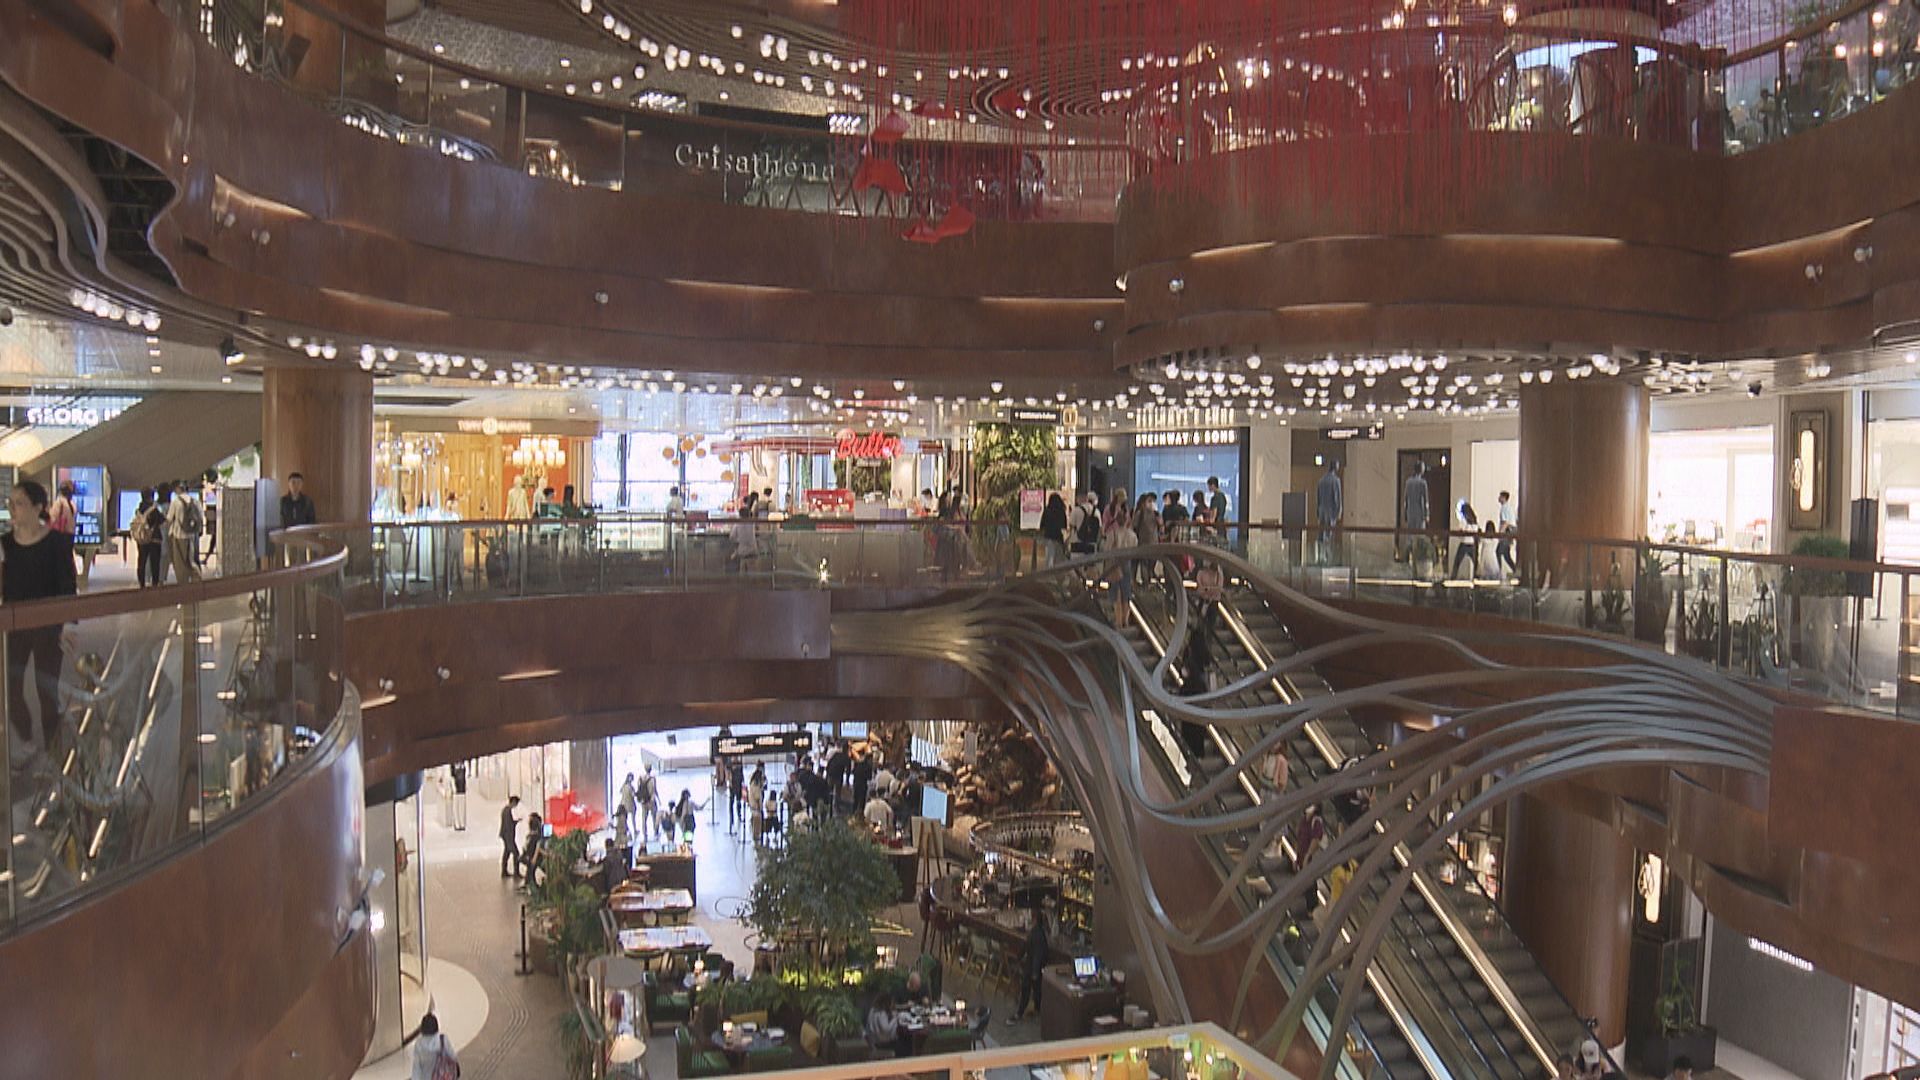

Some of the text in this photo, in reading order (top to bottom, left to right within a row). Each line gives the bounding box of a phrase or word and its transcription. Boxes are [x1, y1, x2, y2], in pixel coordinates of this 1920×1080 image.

[26, 408, 98, 426] GEORG
[836, 428, 902, 460] Butter
[1135, 431, 1189, 447] STEINWAY
[1204, 429, 1235, 444] SONS
